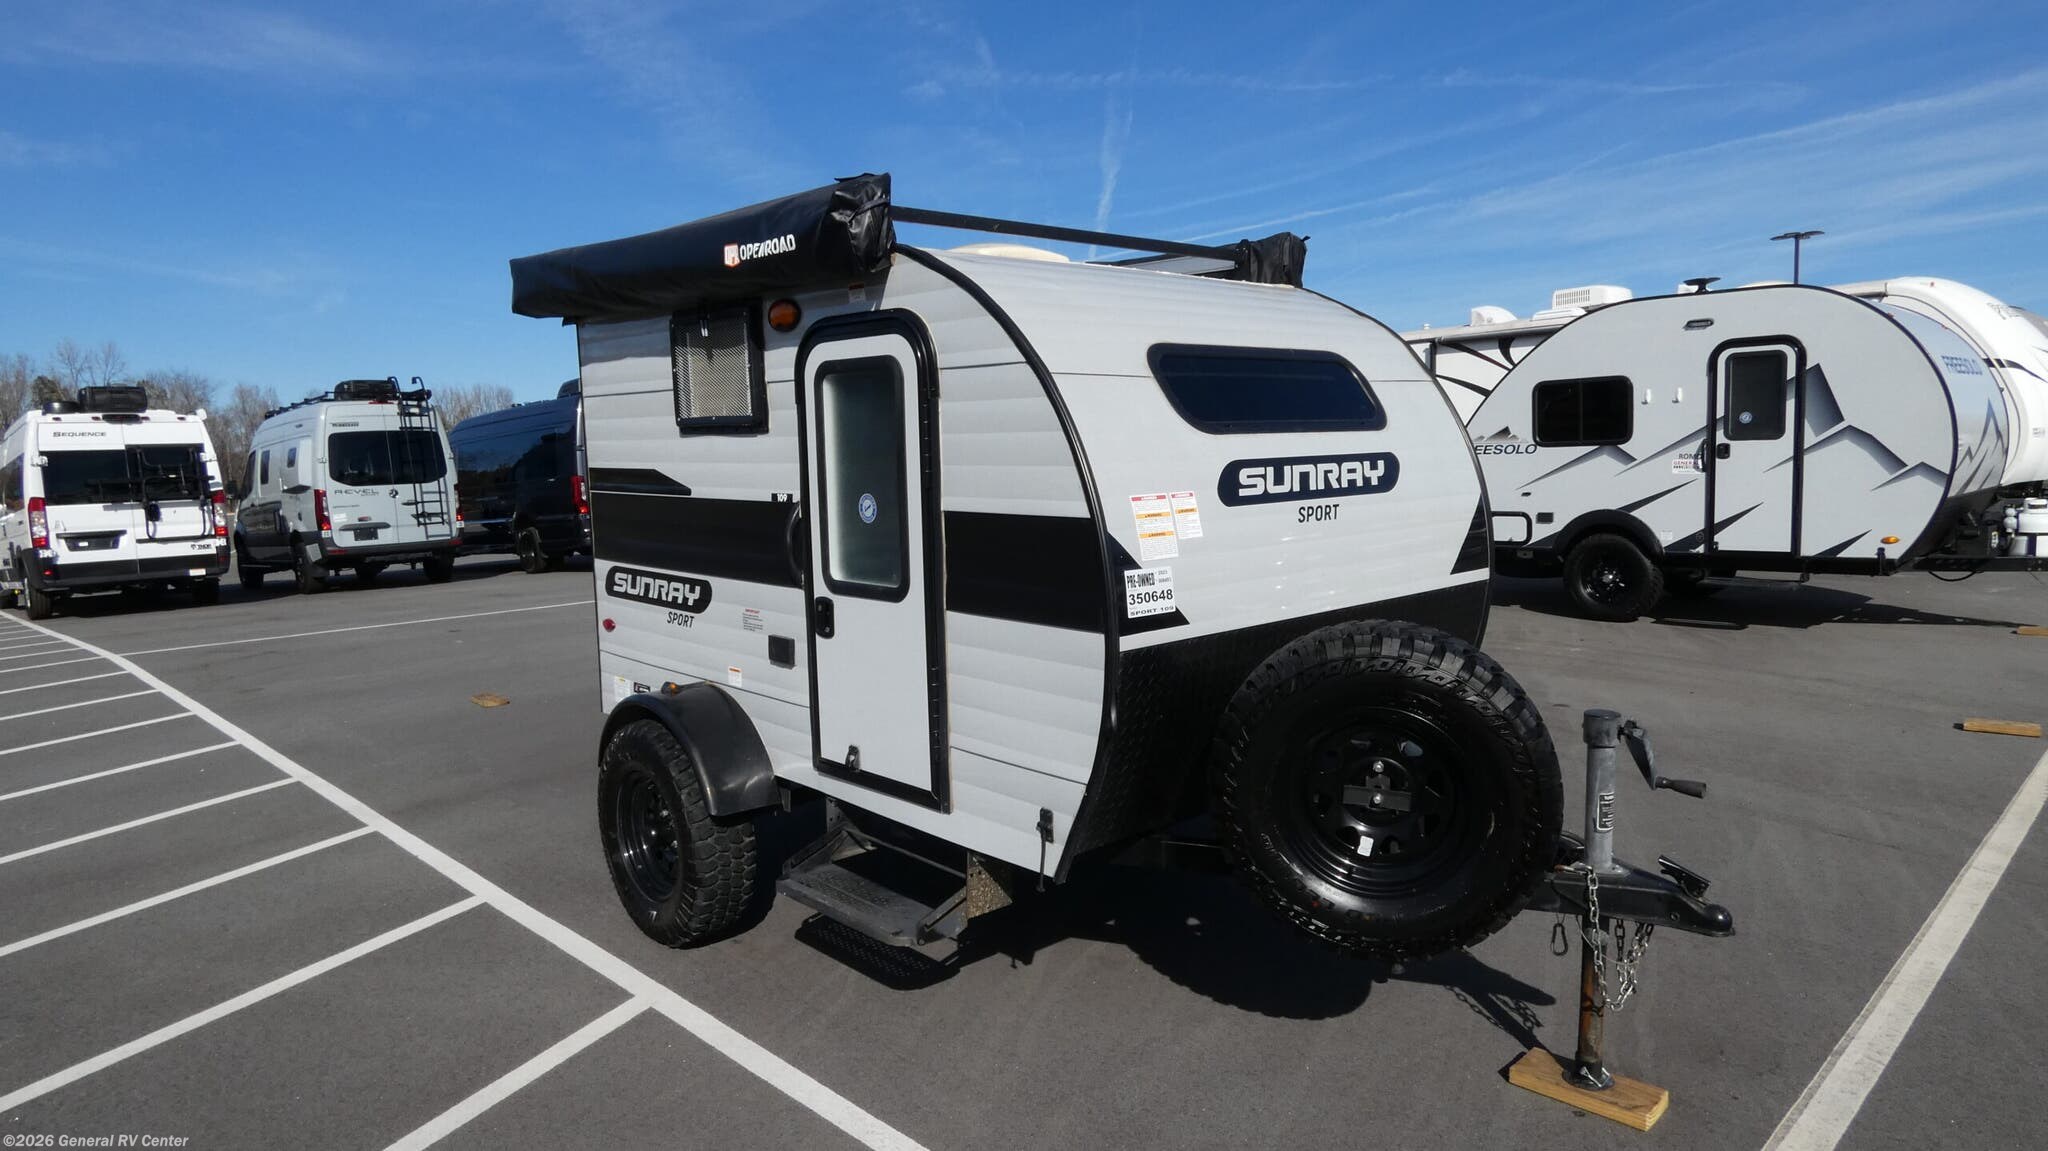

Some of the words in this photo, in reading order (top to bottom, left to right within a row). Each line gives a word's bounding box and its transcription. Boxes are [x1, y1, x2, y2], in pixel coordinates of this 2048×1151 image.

[740, 234, 796, 261] OPENROAD
[1238, 459, 1385, 497] SUNRAY
[335, 487, 377, 495] REVEL
[1298, 504, 1340, 523] SPORT
[613, 571, 701, 606] SUNRAY
[1127, 572, 1155, 589] PRE-OWNED
[1129, 589, 1173, 606] 350648
[667, 611, 695, 629] SPORT
[1130, 608, 1157, 617] SPORT
